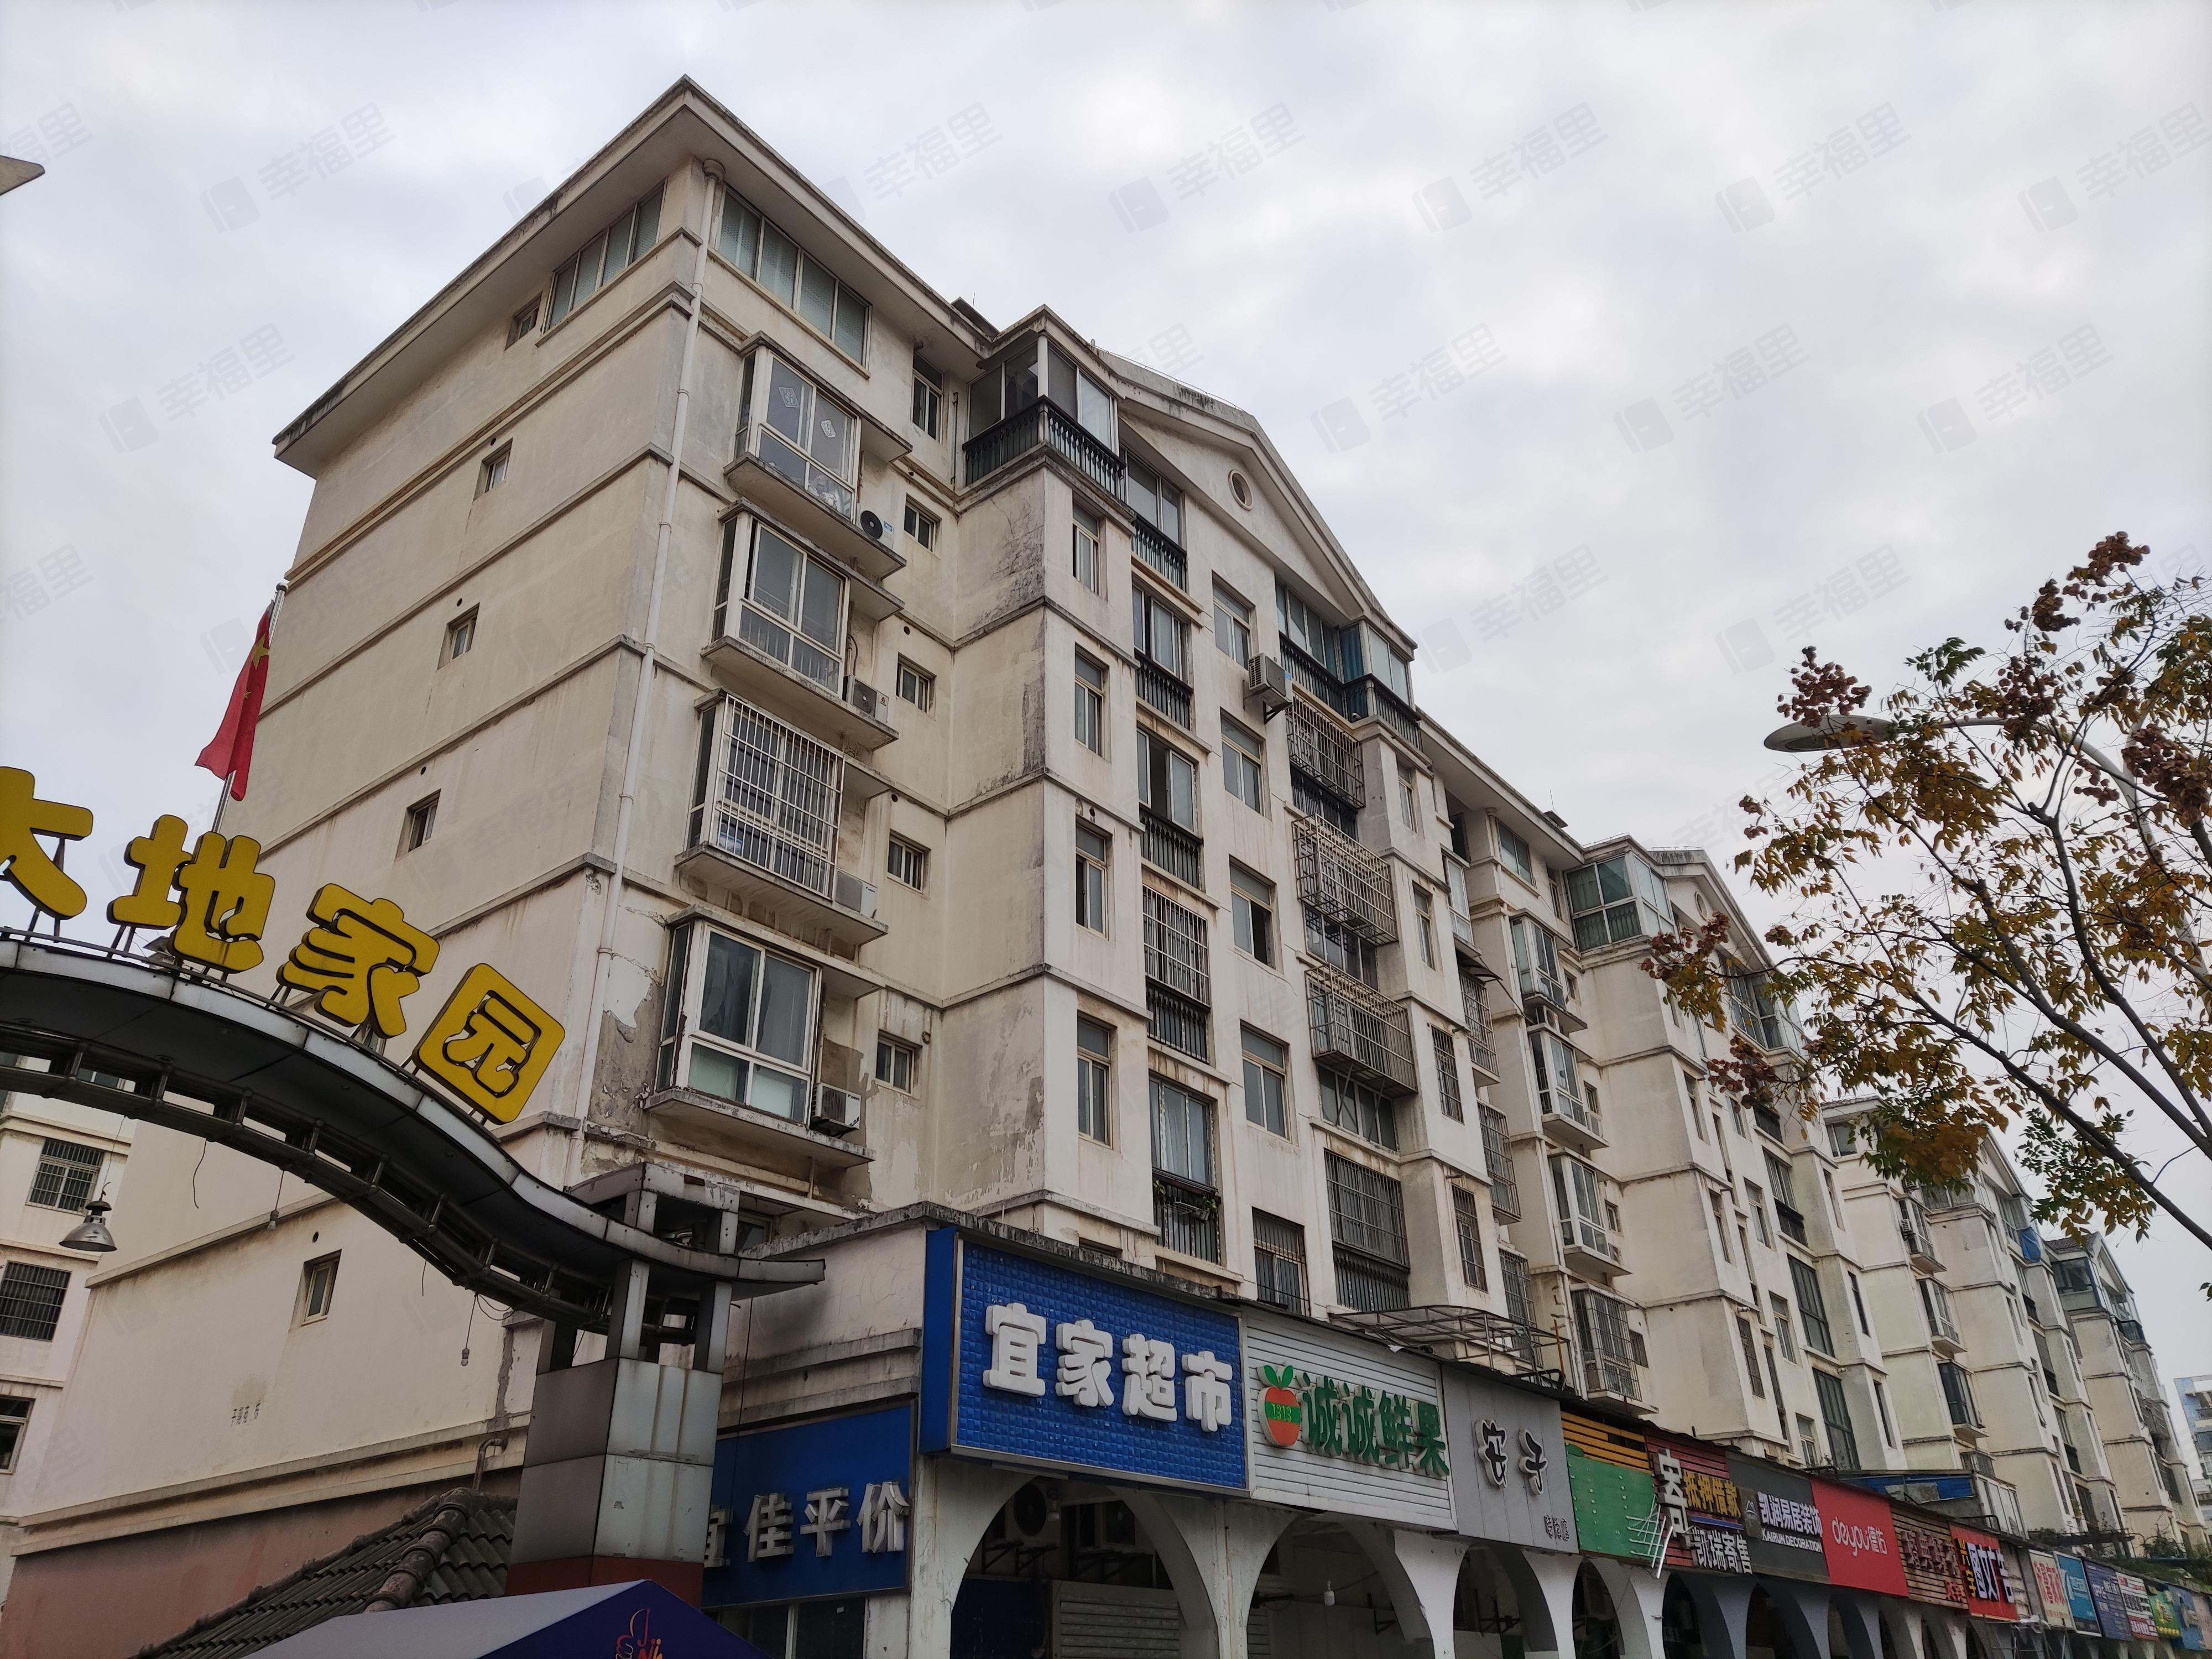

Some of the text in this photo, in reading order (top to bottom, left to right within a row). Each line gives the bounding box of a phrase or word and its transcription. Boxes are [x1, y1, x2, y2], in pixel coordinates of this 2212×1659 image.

[0, 766, 565, 1124] 大地家园
[982, 1302, 1233, 1433] 宜家超市
[1271, 1402, 1292, 1422] 1313
[1297, 1372, 1450, 1477] 诚诚鲜果
[1683, 1469, 1741, 1519] 抵押借款
[1757, 1491, 1823, 1537] 凯润易居装饰
[1691, 1526, 1752, 1575] 凯瑞寄售
[1761, 1527, 1823, 1553] KAIRUN DECORATION
[1832, 1516, 1869, 1557] deyou
[1967, 1542, 2015, 1603] 图文广告
